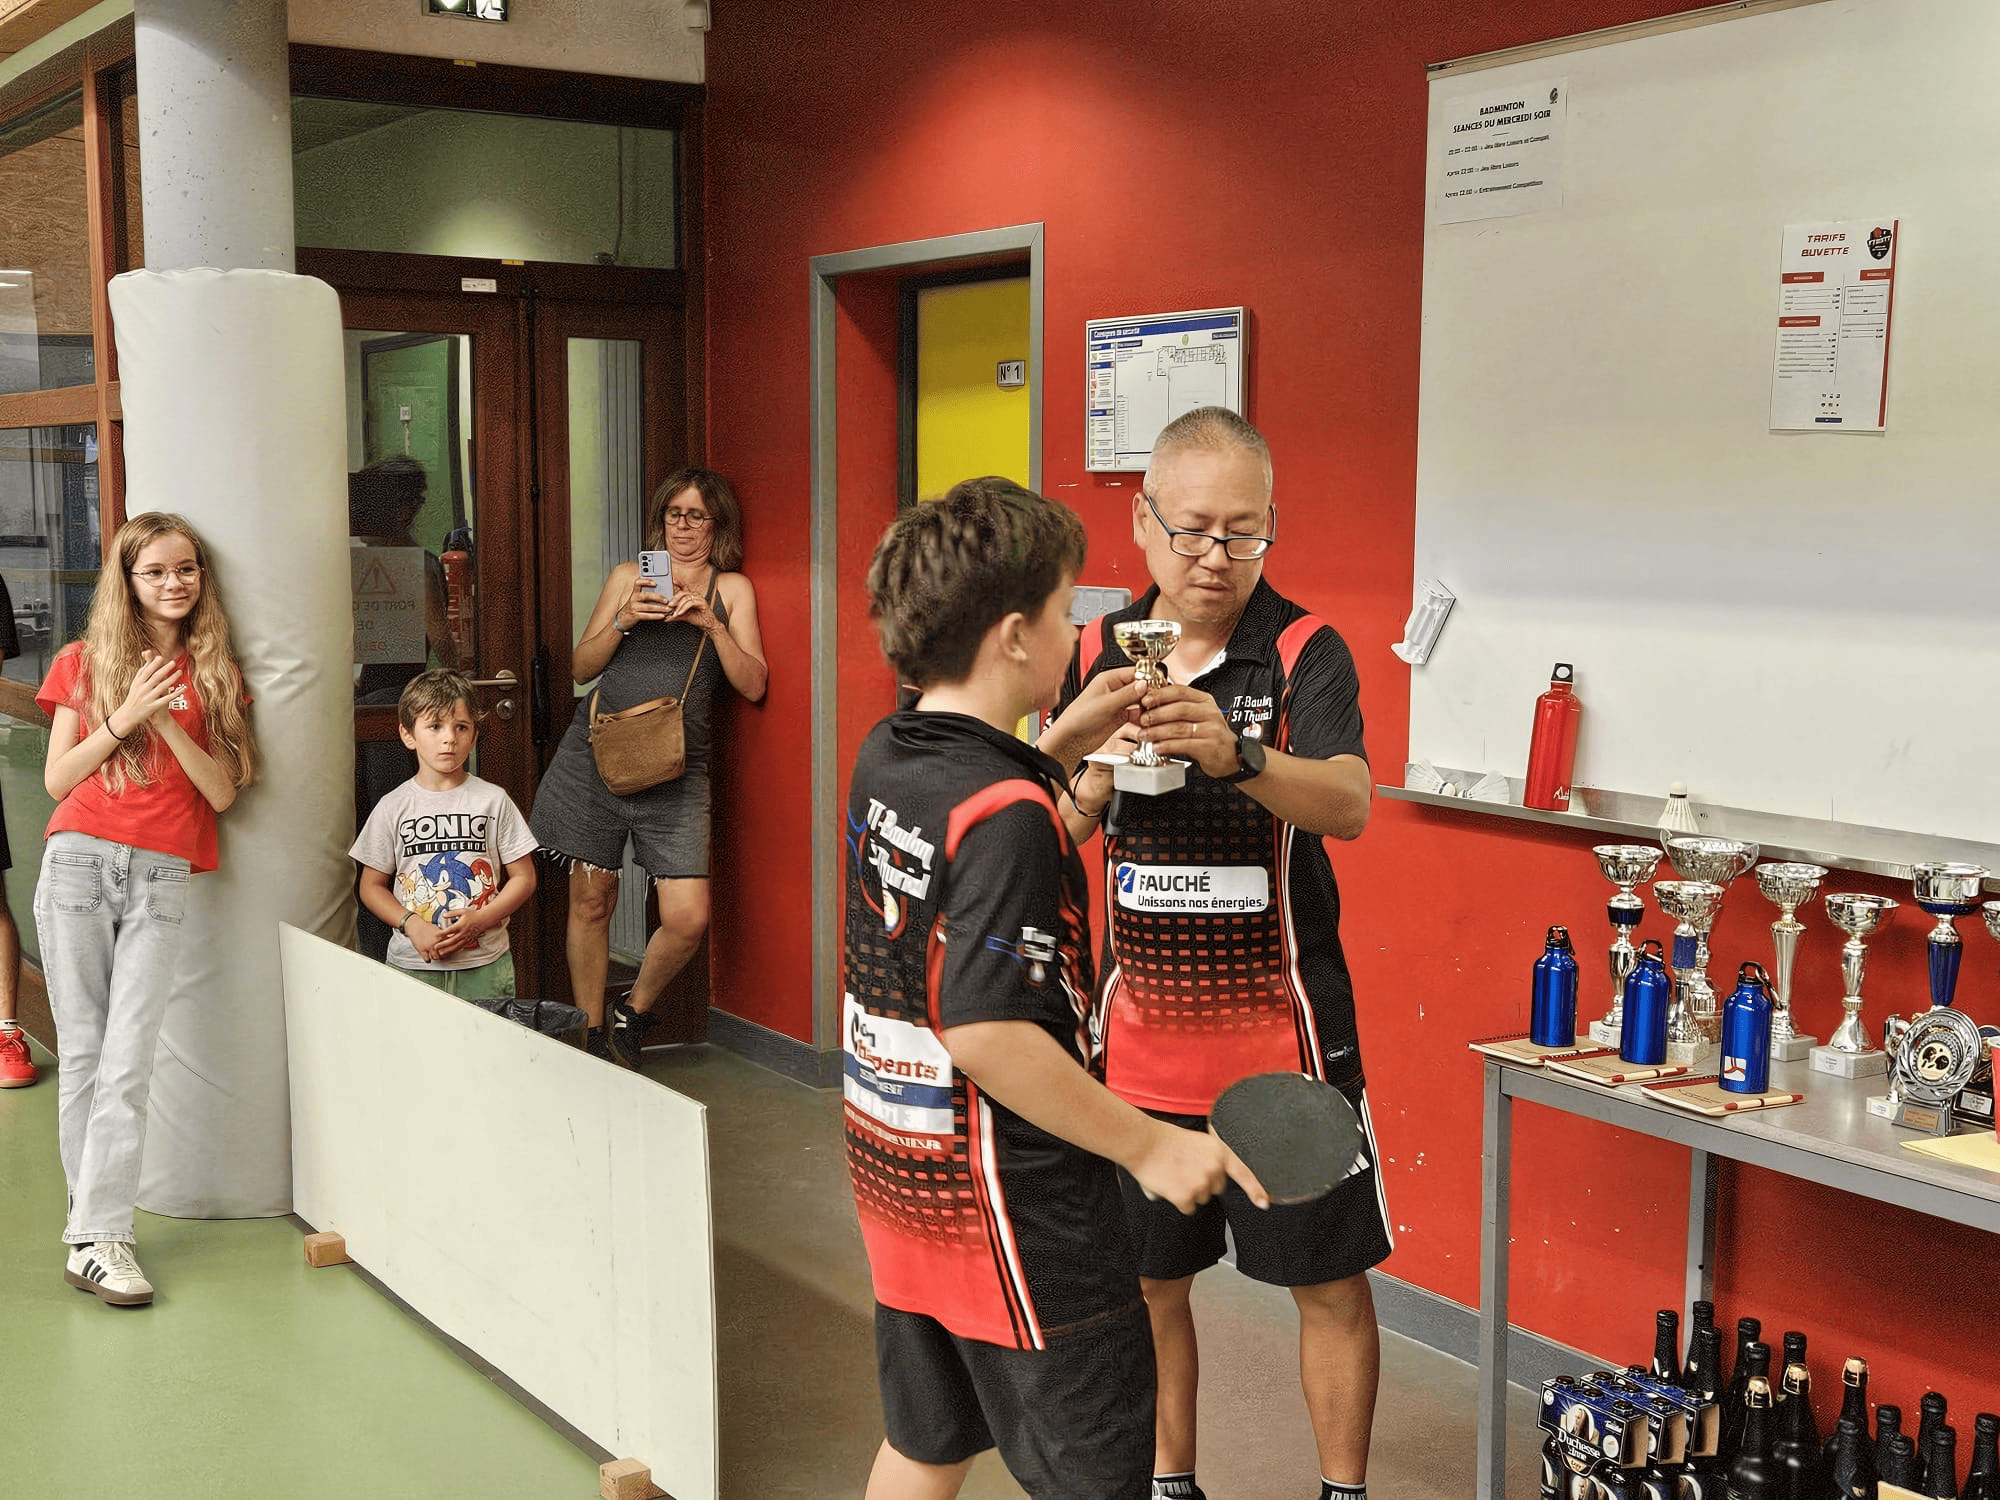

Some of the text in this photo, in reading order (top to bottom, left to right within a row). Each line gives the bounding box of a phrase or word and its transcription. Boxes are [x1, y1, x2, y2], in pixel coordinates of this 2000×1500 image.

[1479, 101, 1525, 116] BADMINTON
[1484, 120, 1495, 129] DU
[1496, 112, 1532, 126] MERCREDI
[1534, 109, 1551, 120] SOIR
[1807, 233, 1846, 243] TARIFS
[1801, 246, 1849, 257] BUVETTE
[1000, 364, 1020, 381] N° 1
[400, 814, 488, 844] SONIC
[1139, 871, 1210, 892] FAUCHÉ
[1138, 895, 1265, 910] Unissons nos énergies.
[1557, 1428, 1601, 1459] Duchesse
